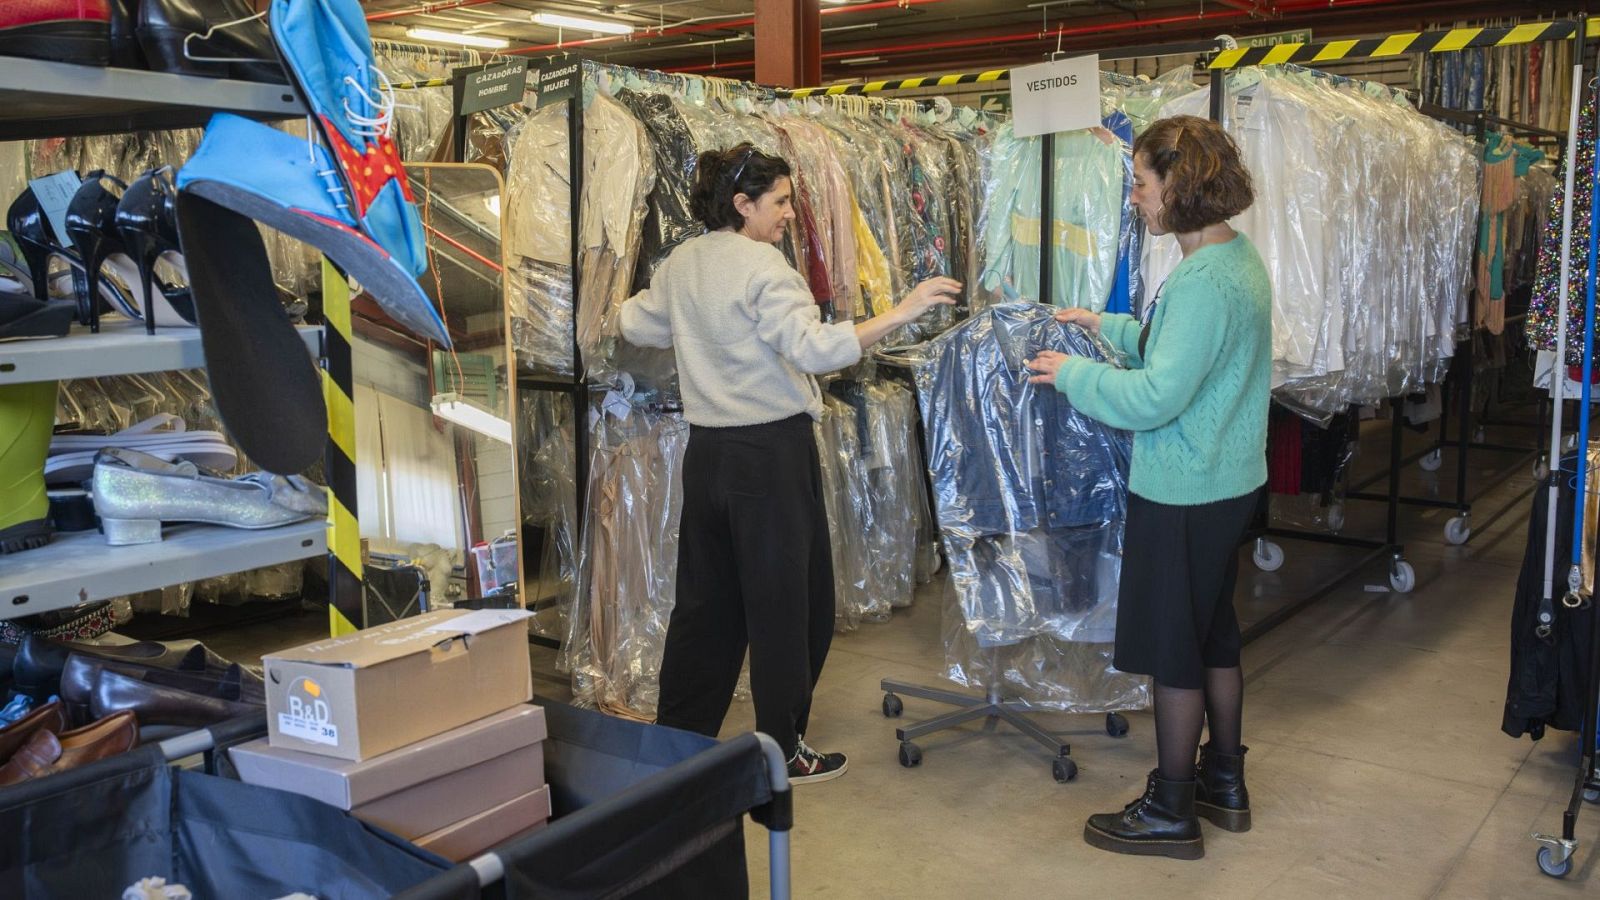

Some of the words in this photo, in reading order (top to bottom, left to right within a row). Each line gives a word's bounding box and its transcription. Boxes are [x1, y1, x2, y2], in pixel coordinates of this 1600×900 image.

[476, 66, 523, 84] CAZADORAS
[541, 64, 578, 82] CAZADORAS
[478, 84, 509, 97] HOMBRE
[543, 79, 570, 93] MUJER
[1027, 74, 1078, 92] VESTIDOS
[290, 695, 329, 725] B&D
